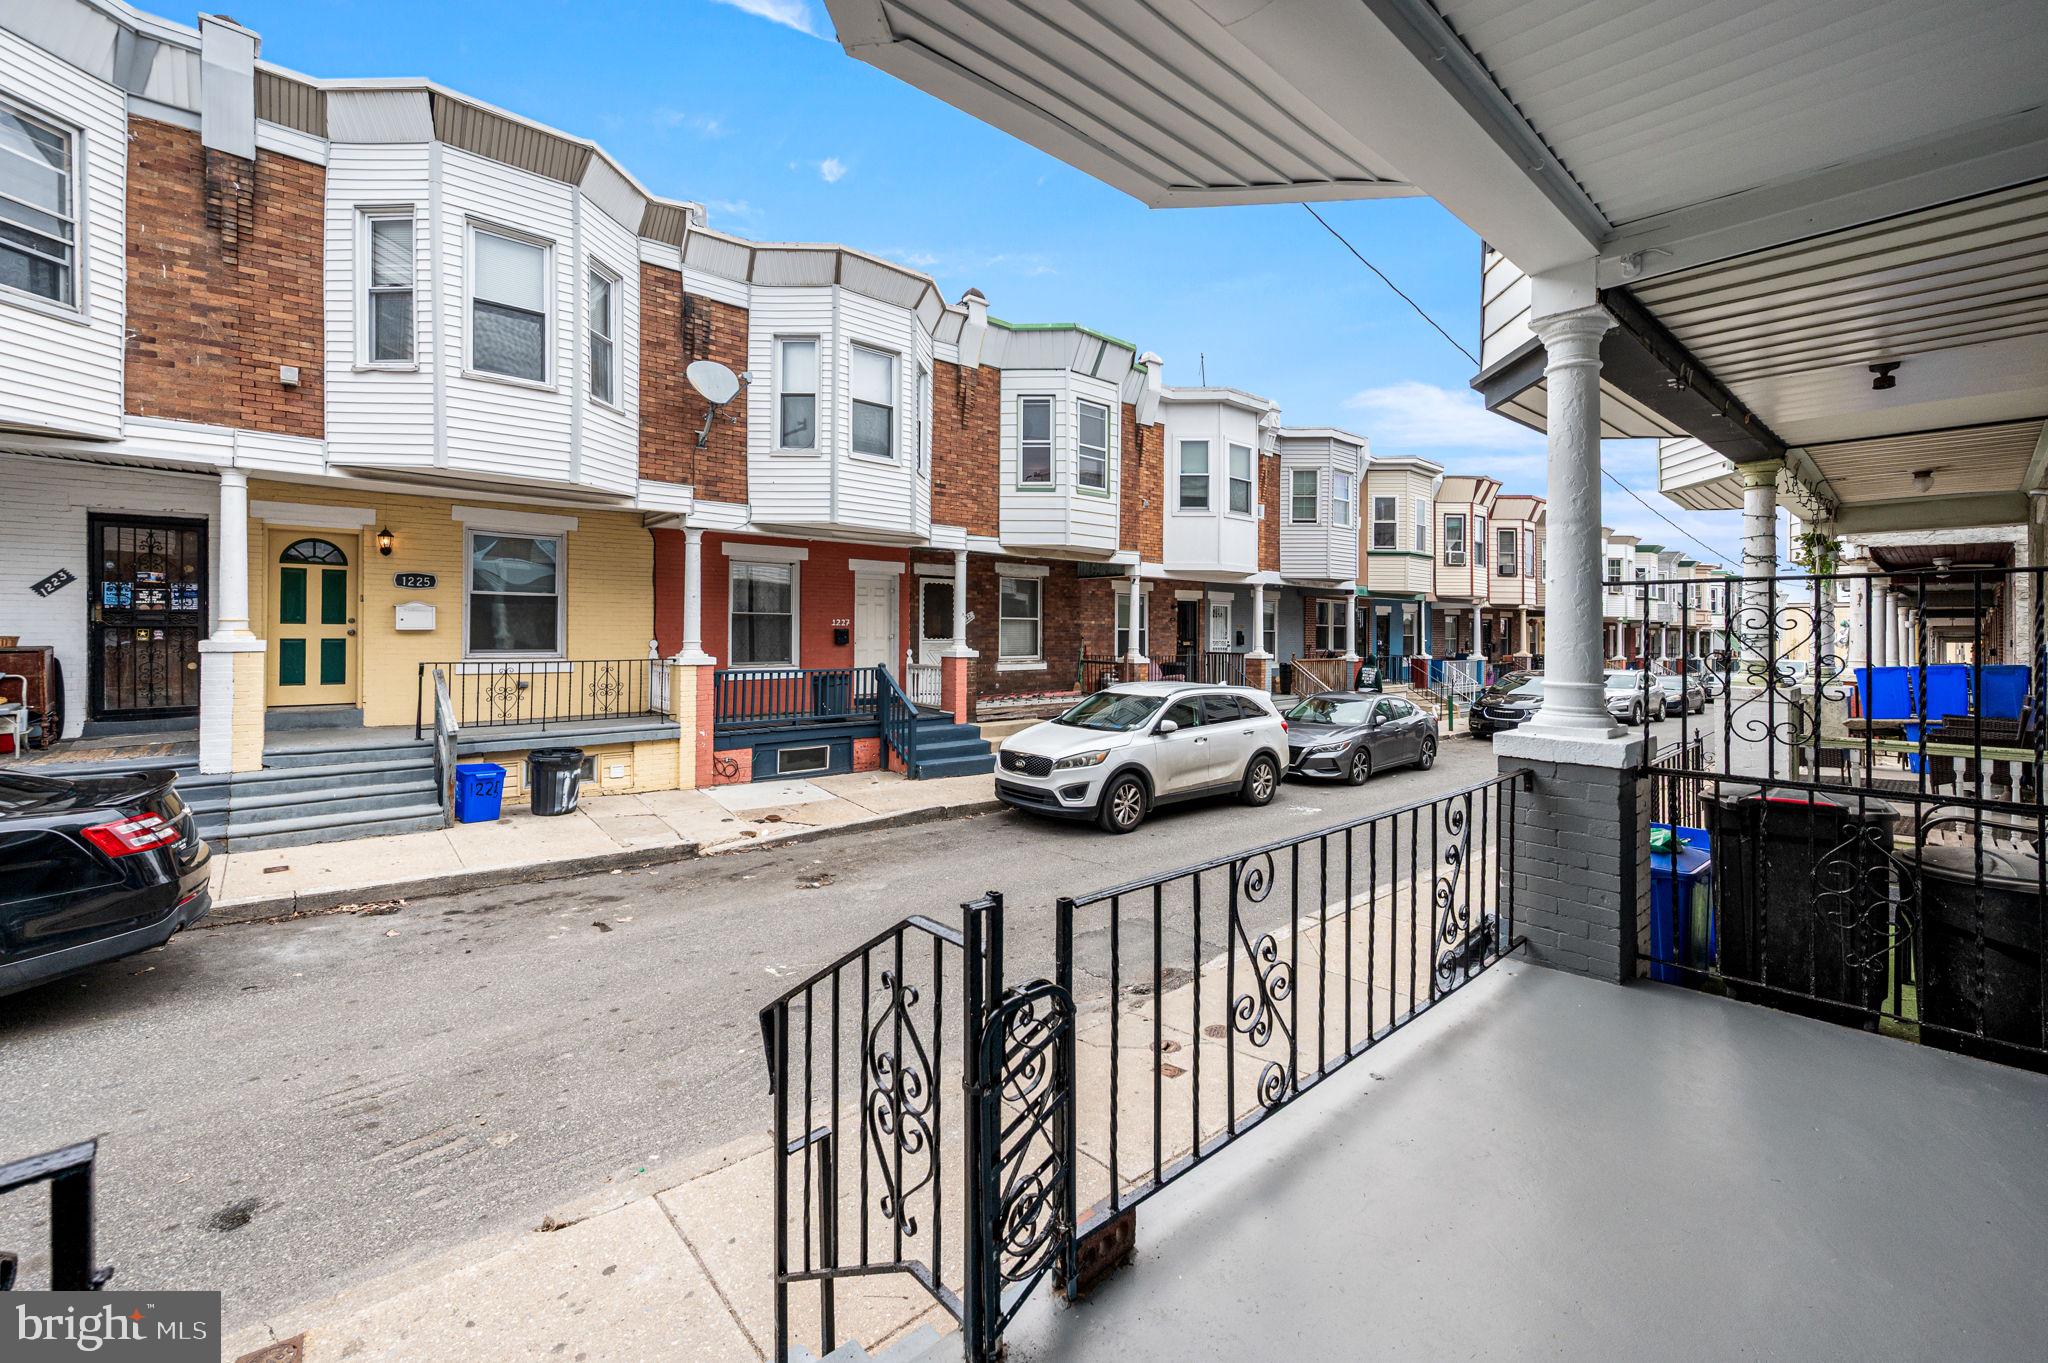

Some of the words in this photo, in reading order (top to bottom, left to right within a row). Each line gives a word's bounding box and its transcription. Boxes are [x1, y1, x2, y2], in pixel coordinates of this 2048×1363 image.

[40, 571, 68, 597] 1223
[402, 576, 431, 587] 1225
[831, 618, 850, 626] 1227
